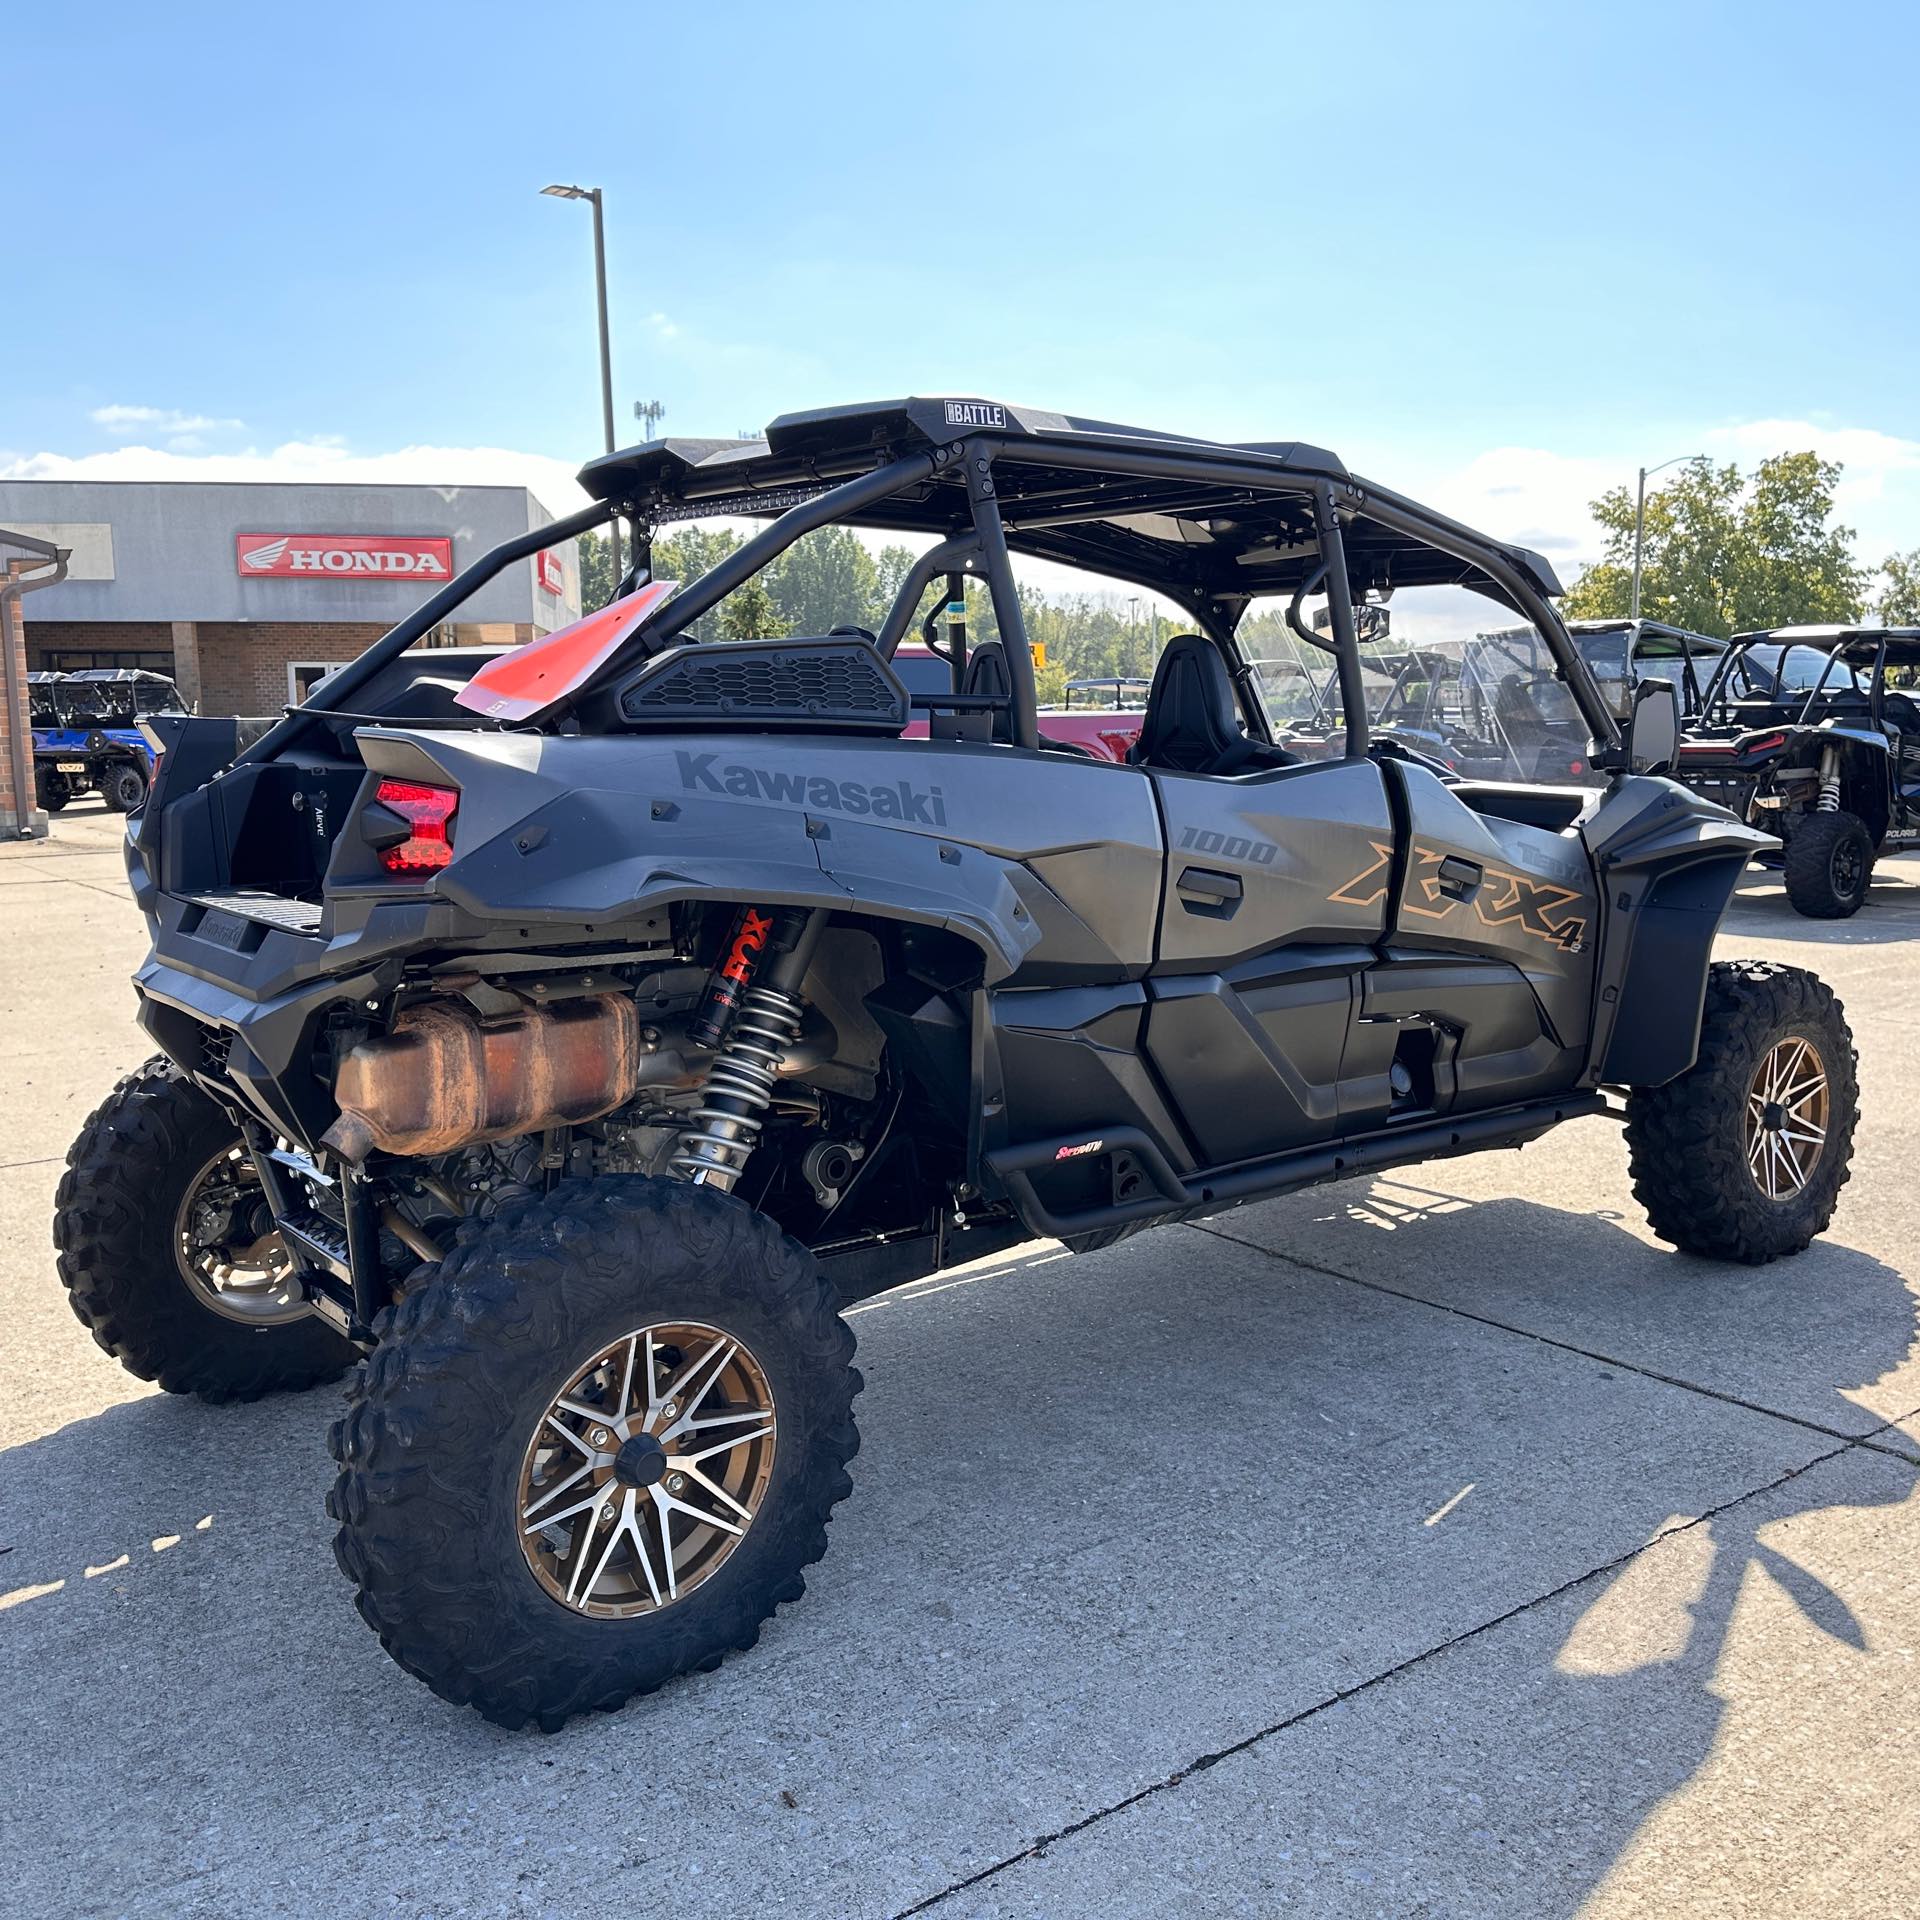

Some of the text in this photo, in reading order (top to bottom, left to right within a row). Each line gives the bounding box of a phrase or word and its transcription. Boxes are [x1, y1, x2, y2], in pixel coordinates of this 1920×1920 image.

[954, 404, 1002, 425] BATTLE
[289, 550, 447, 573] HONDA
[674, 751, 947, 827] Kawasaki
[1180, 826, 1278, 865] 1000
[1885, 829, 1917, 838] POLARIS
[722, 908, 773, 987] FOX
